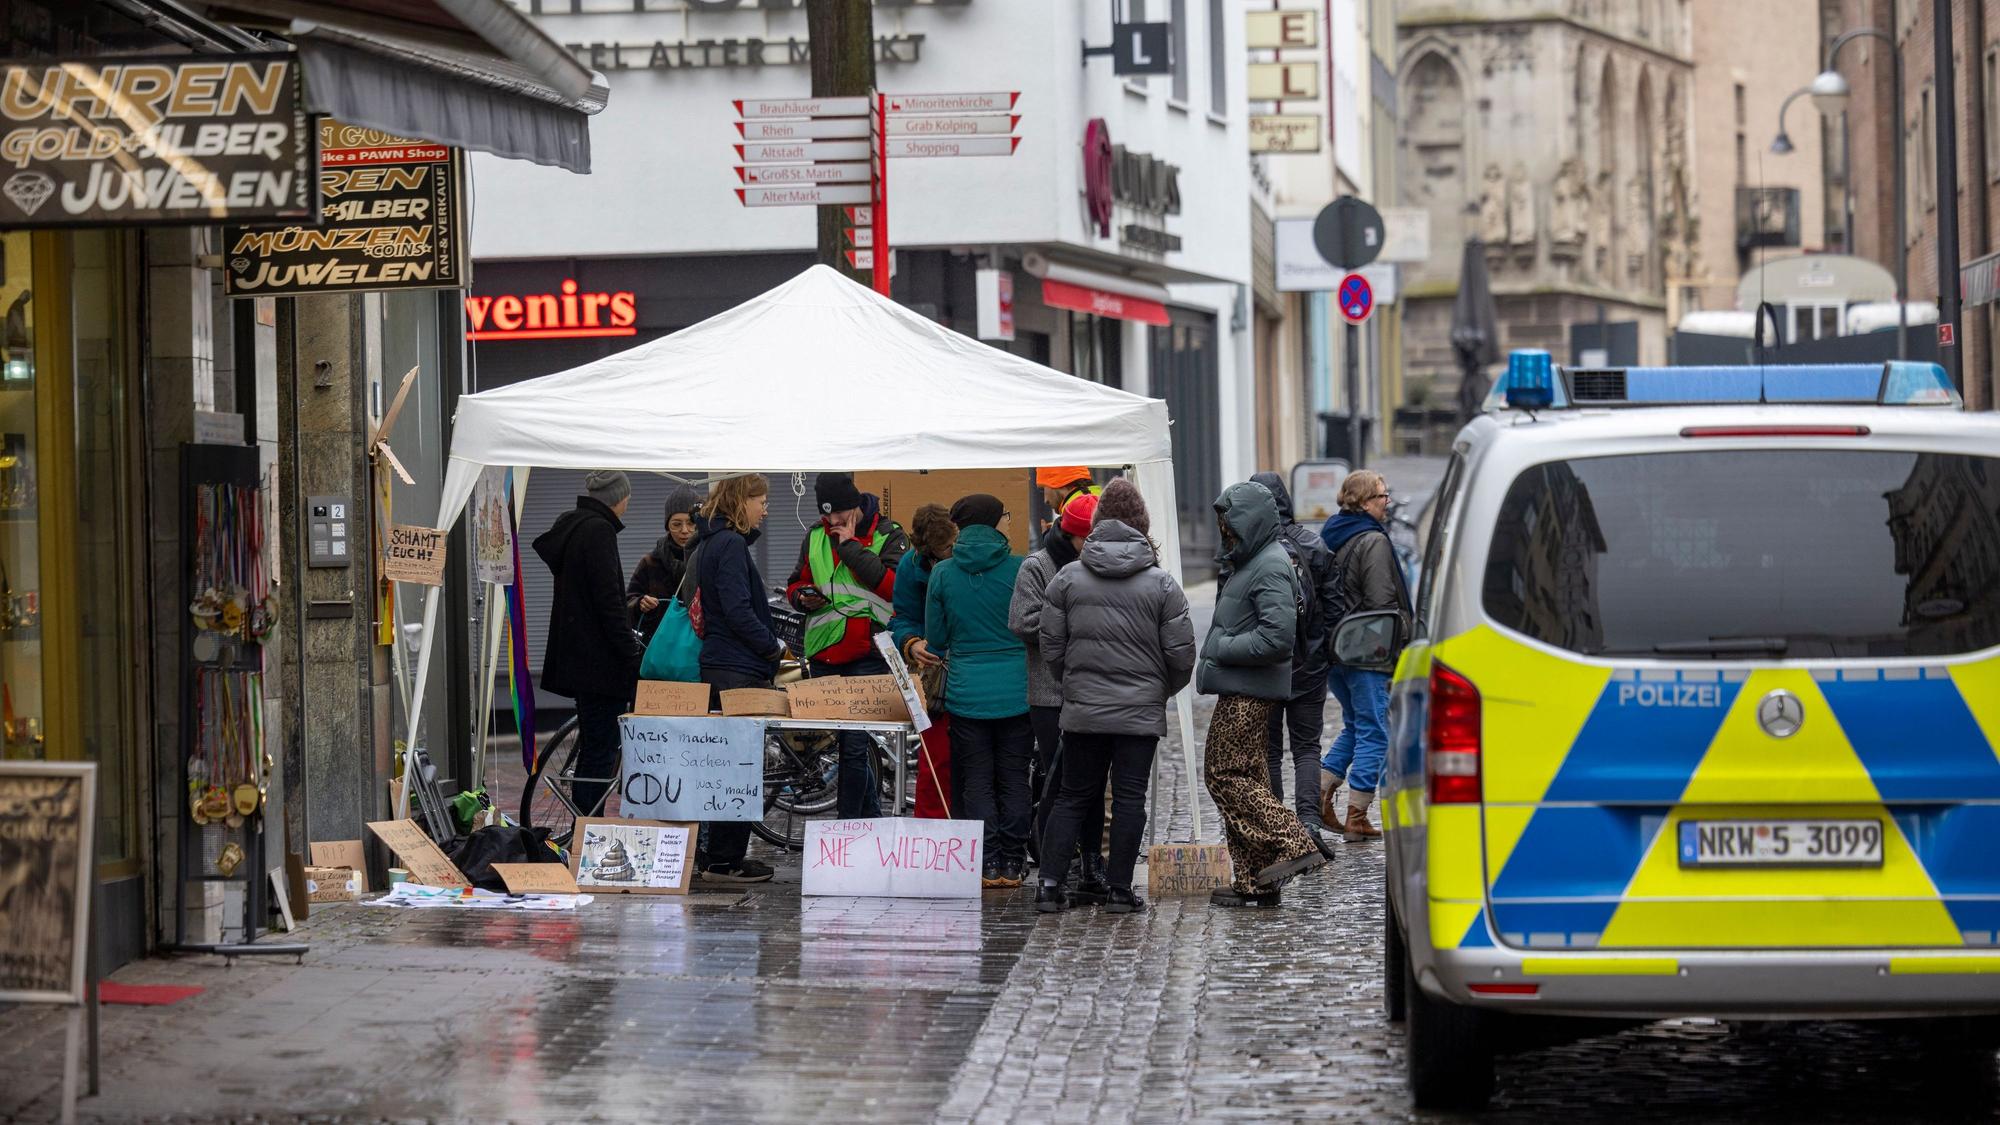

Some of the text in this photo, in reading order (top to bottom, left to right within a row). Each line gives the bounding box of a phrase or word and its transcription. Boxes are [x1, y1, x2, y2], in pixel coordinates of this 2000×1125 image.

[566, 34, 925, 71] TEL ALTER MKT
[1132, 32, 1152, 66] L
[1, 61, 289, 125] UHREN
[759, 103, 821, 114] Brauhäuser
[904, 96, 994, 110] Minoritenkirche
[762, 125, 794, 136] Rhein
[905, 120, 978, 134] Grab Kolping
[320, 152, 345, 163] ike
[359, 150, 404, 161] PAWN
[407, 148, 446, 160] Shop
[761, 147, 805, 158] Altstadt
[905, 142, 960, 156] Shopping
[806, 168, 843, 179] Martin
[320, 166, 430, 198] REN
[435, 168, 449, 235] VERKAUF
[762, 190, 823, 202] Alter Markt
[231, 226, 434, 258] MÜNZEN
[371, 243, 423, 258] COINS
[466, 279, 637, 331] venirs
[315, 360, 333, 389] 2
[335, 506, 341, 518] 2
[392, 547, 434, 561] EUCH!
[823, 698, 846, 707] Das
[849, 697, 870, 706] sind
[872, 697, 889, 706] die
[1618, 683, 1721, 708] POLIZEI
[624, 724, 729, 746] Nazis machen
[624, 772, 682, 806] CDU
[695, 778, 723, 790] was
[821, 821, 873, 834] SCHON
[1699, 825, 1755, 856] NRW
[875, 835, 978, 873] WIEDER!
